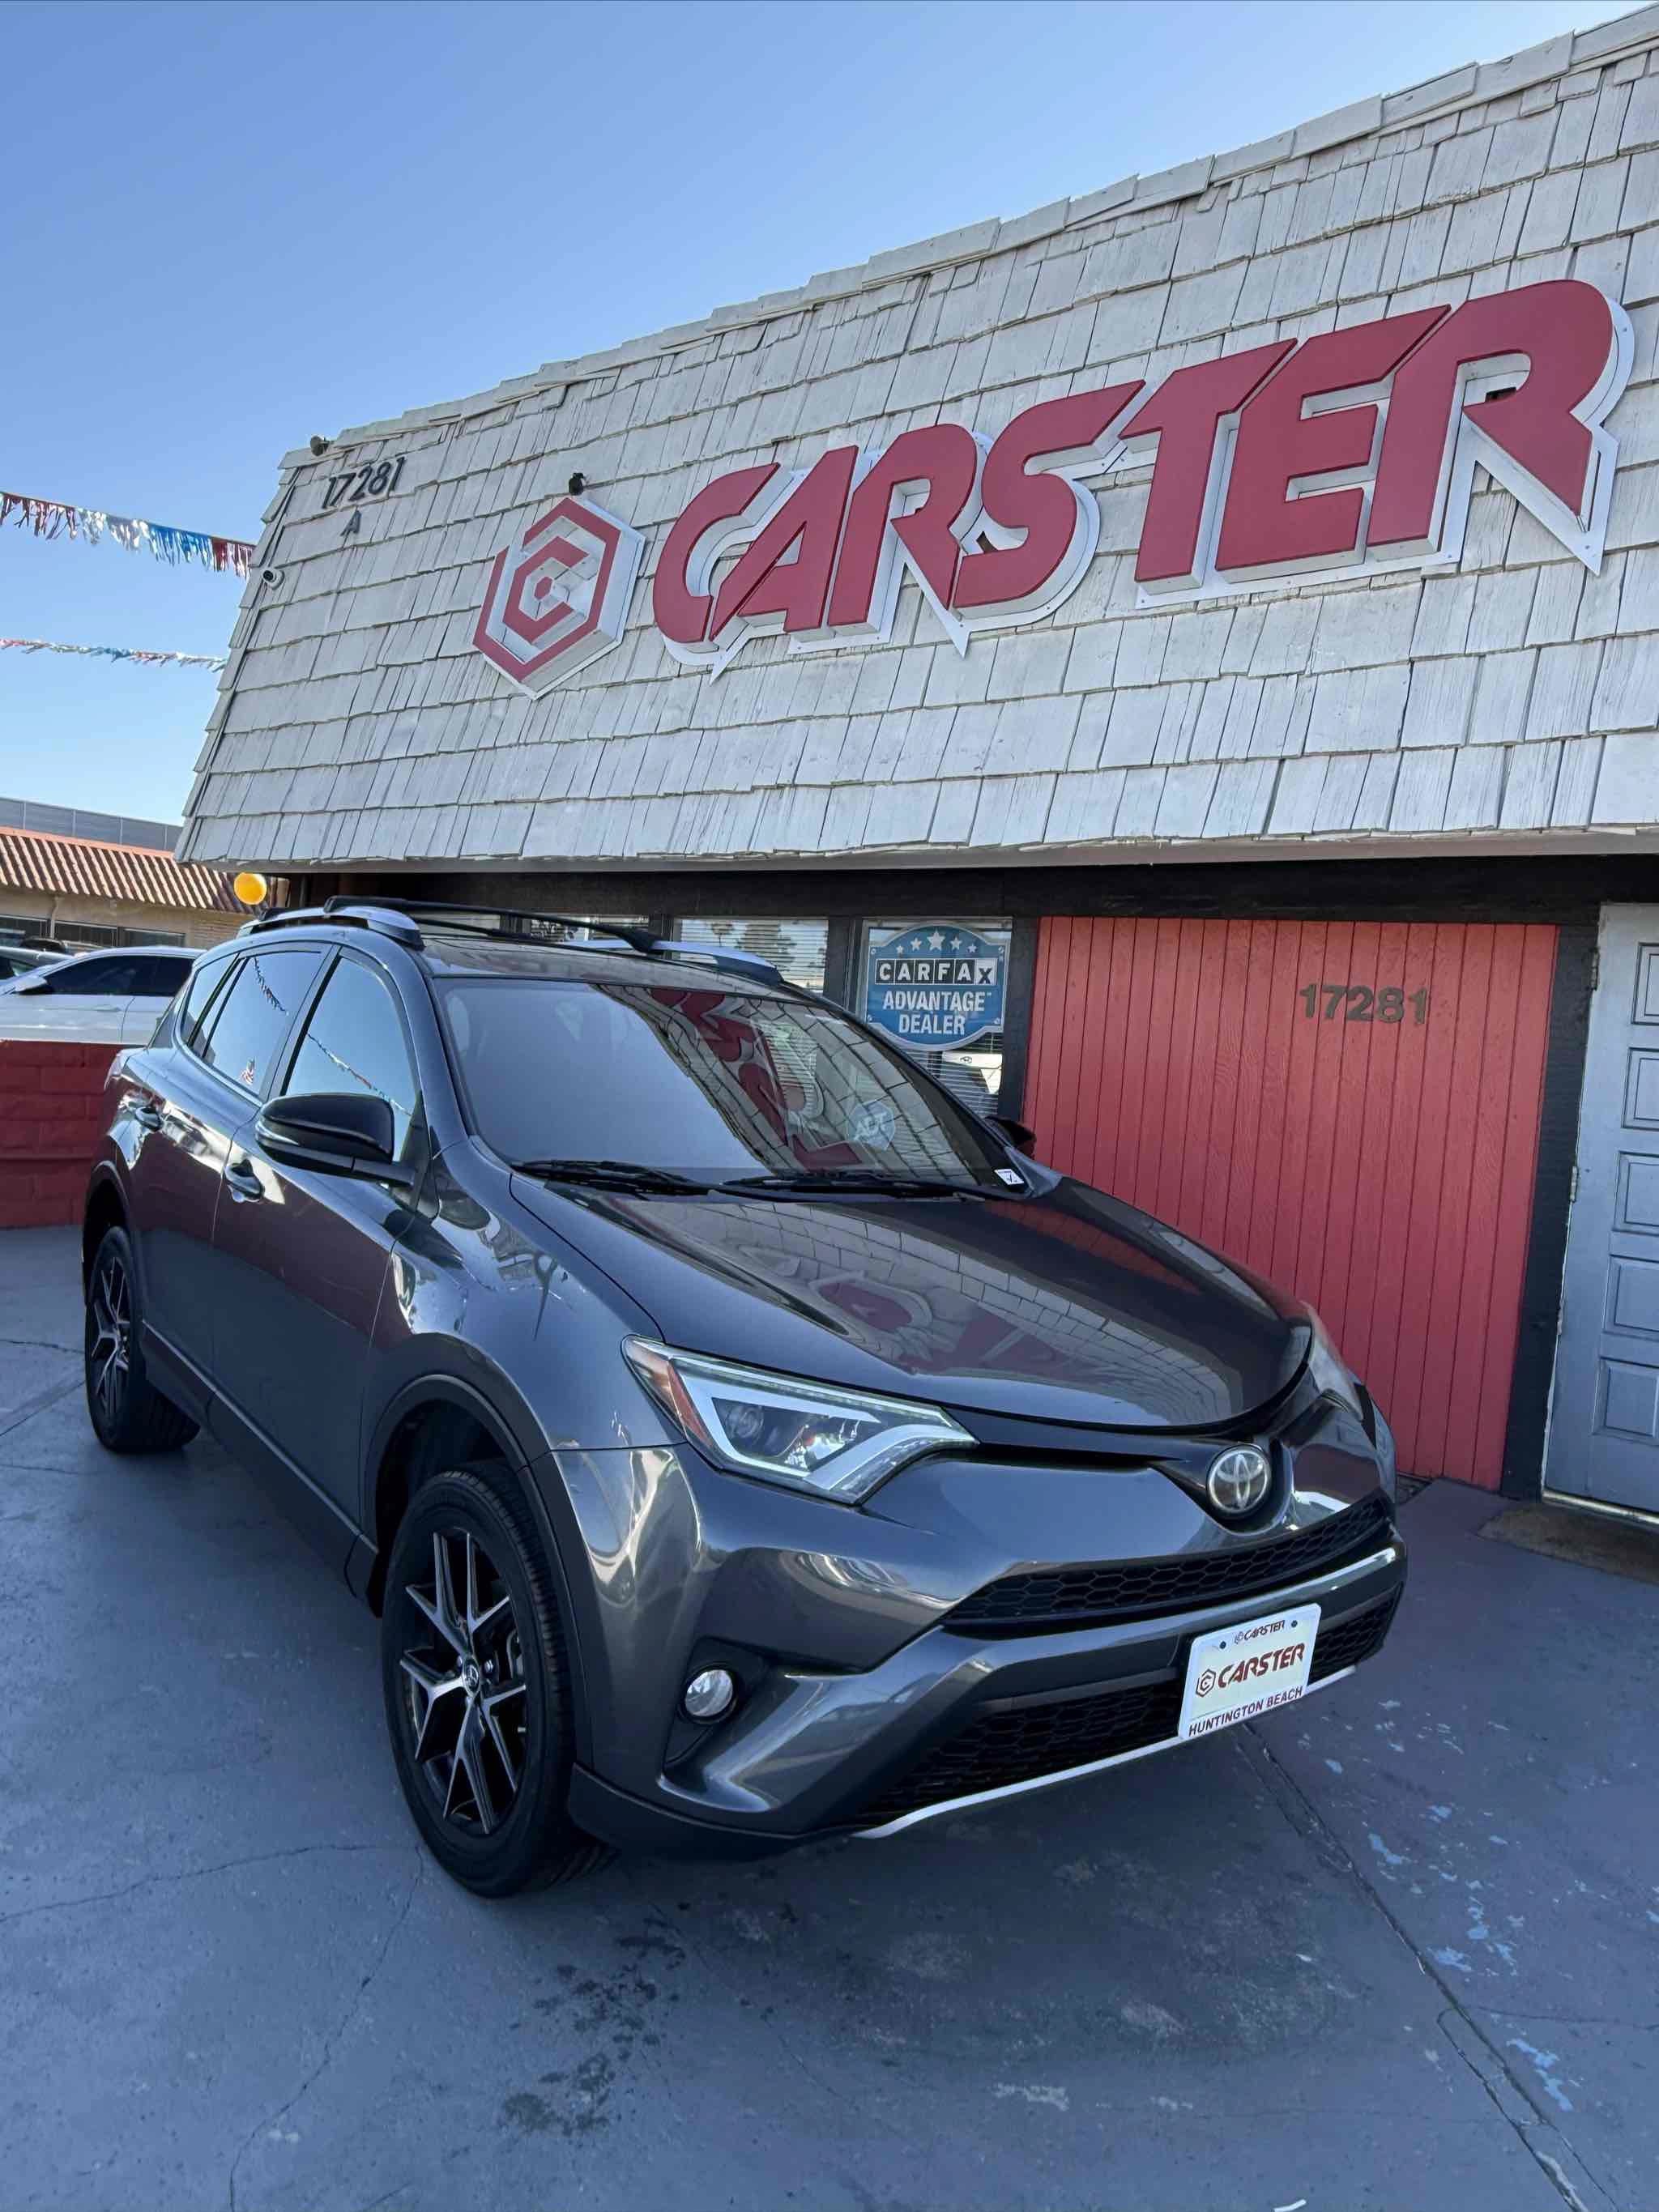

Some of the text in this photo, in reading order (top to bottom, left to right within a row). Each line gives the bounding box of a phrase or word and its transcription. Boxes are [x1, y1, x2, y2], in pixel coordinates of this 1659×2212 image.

[651, 278, 1618, 648] CARSTER
[322, 457, 404, 509] 17281
[340, 509, 361, 536] A
[878, 961, 992, 985] CARFAX
[883, 991, 986, 1012] ADVANTAGE
[1299, 984, 1427, 1025] 17281
[898, 1014, 966, 1035] DEALER
[1243, 1619, 1286, 1641] CARSTER
[1218, 1643, 1306, 1688] CARSTER
[1188, 1686, 1303, 1737] HUNTINGTON BEACH
